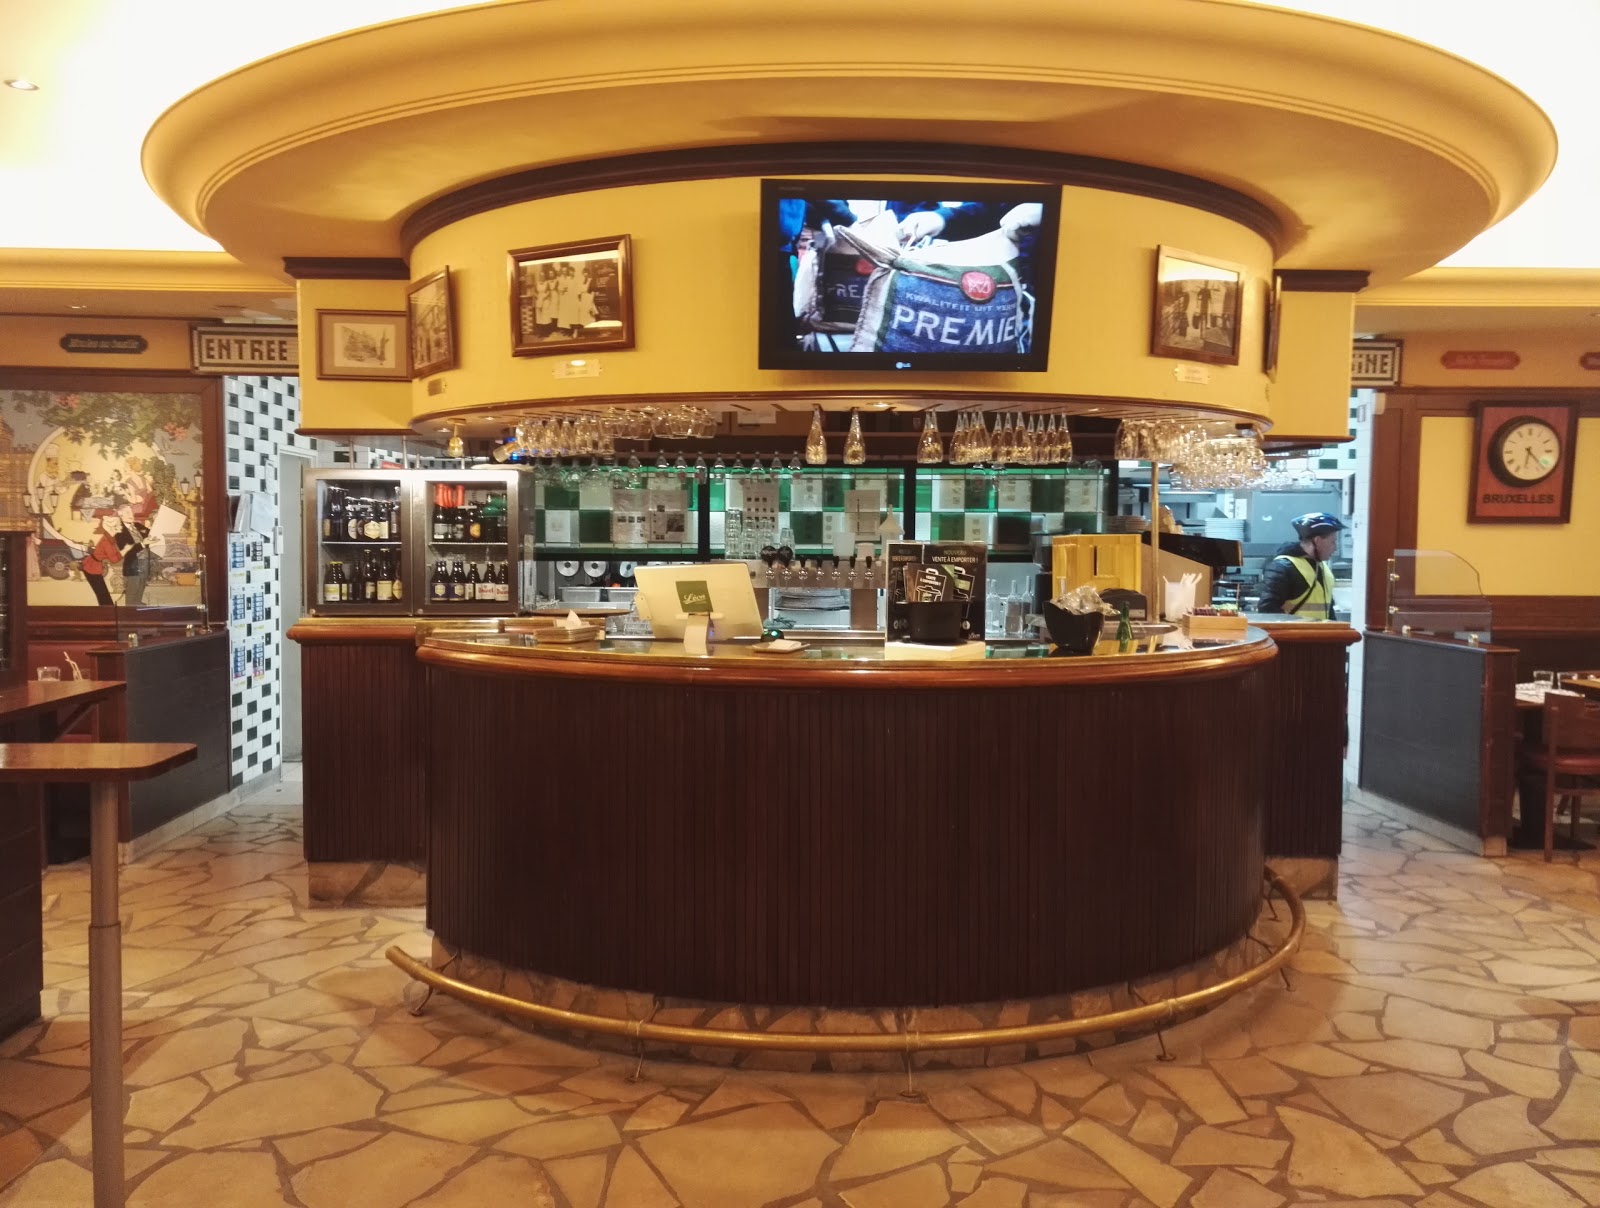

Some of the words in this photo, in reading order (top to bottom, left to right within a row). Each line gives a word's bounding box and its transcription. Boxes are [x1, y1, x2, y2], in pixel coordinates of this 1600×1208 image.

[891, 304, 1016, 346] PREMIE
[205, 338, 288, 361] ENTREE
[1482, 493, 1555, 505] BRUXELLES
